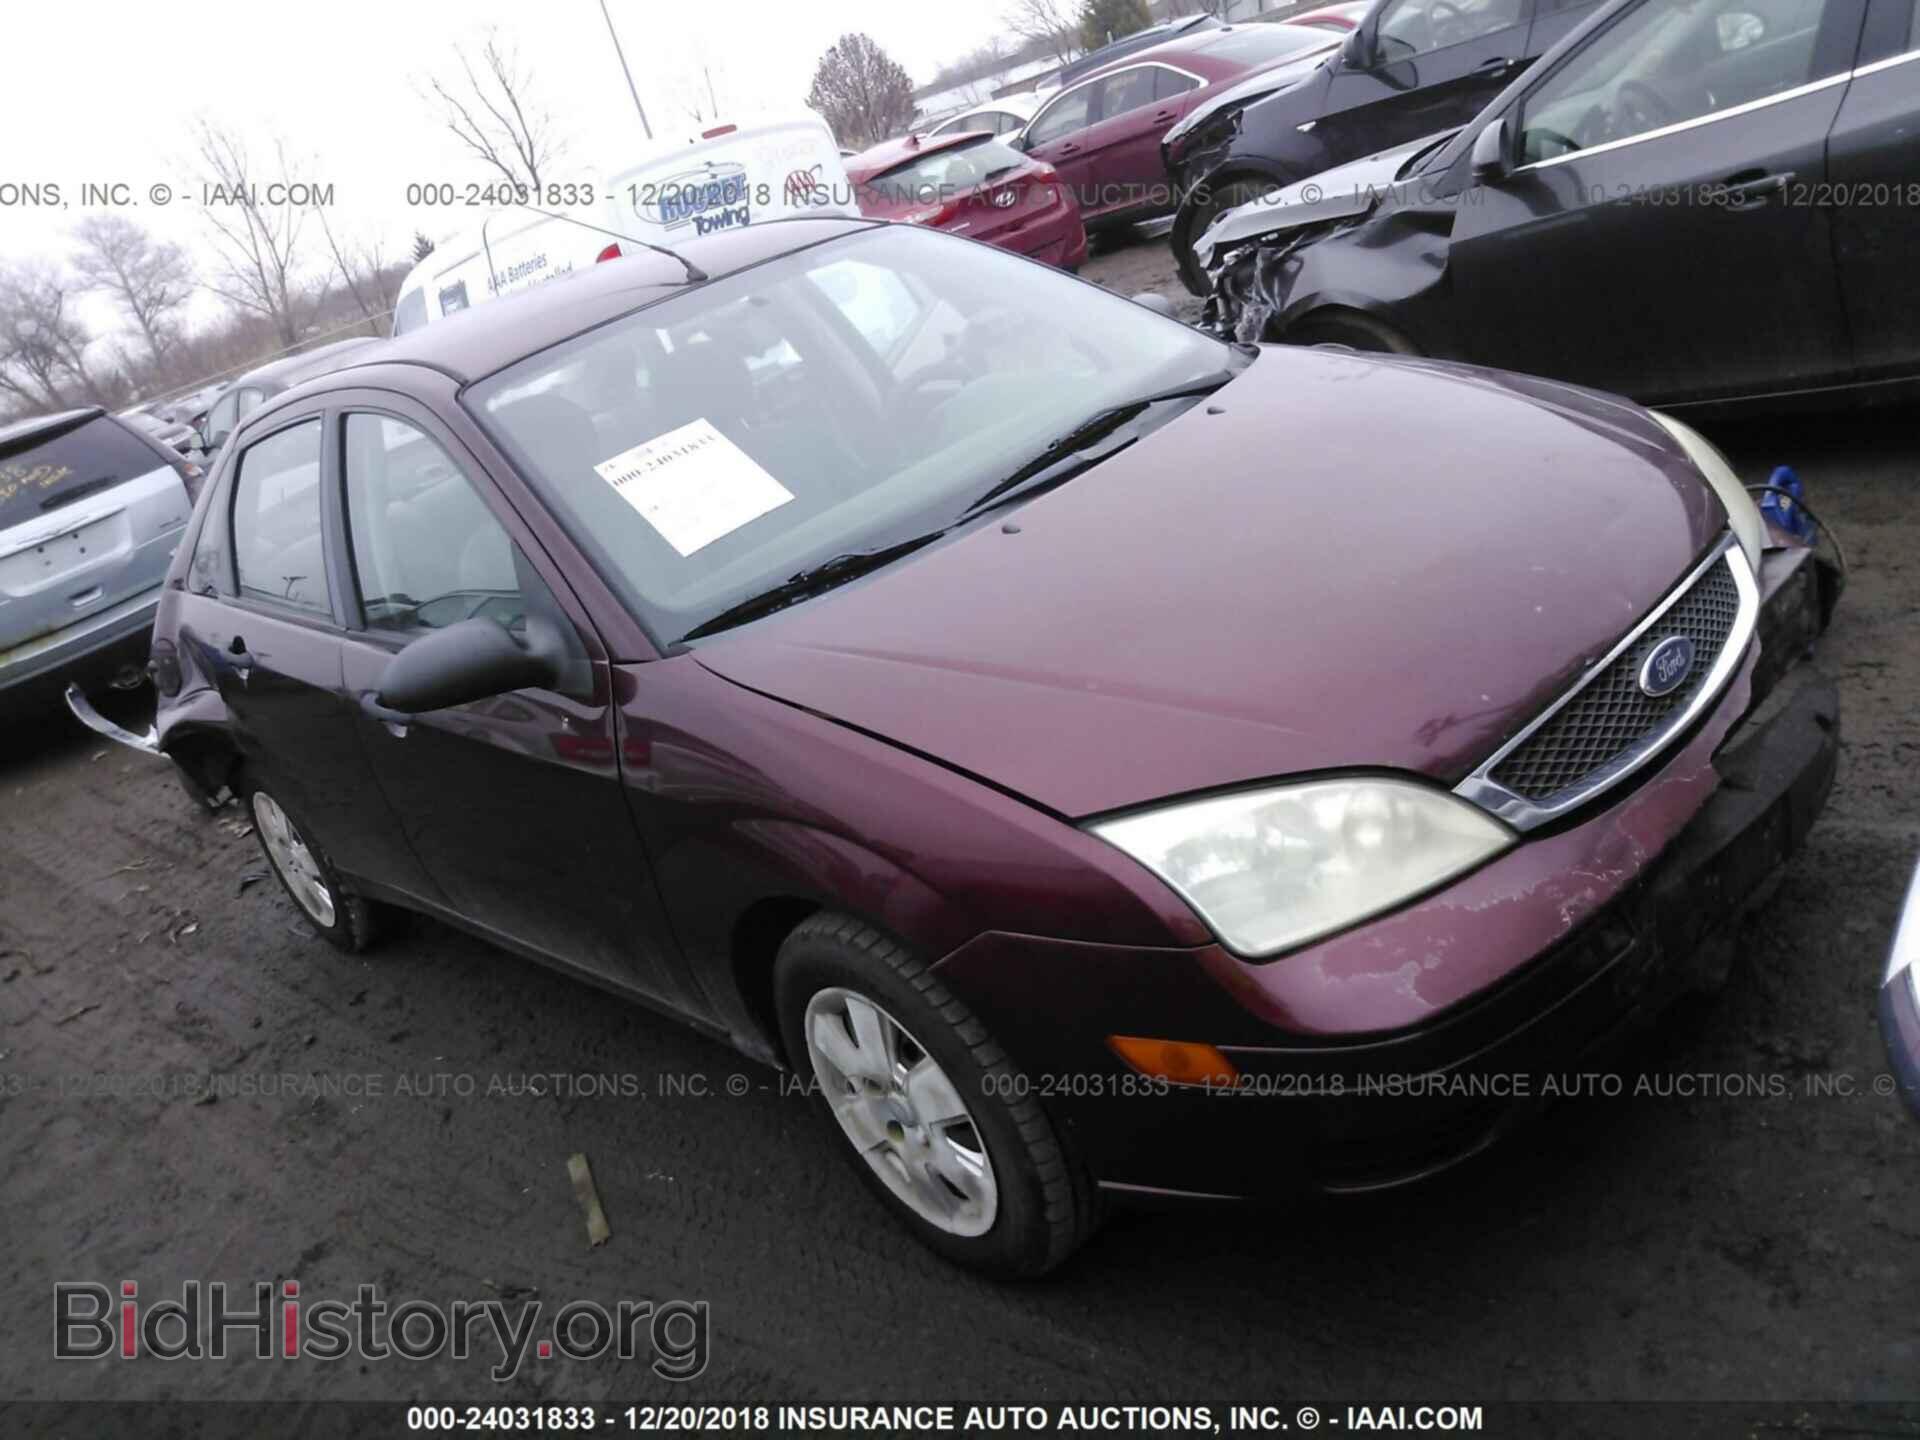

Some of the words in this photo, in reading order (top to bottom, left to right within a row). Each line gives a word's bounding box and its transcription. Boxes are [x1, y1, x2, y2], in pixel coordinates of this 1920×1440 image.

[692, 205, 750, 235] Towing
[508, 253, 548, 283] Batteries
[1656, 647, 1686, 682] Ford
